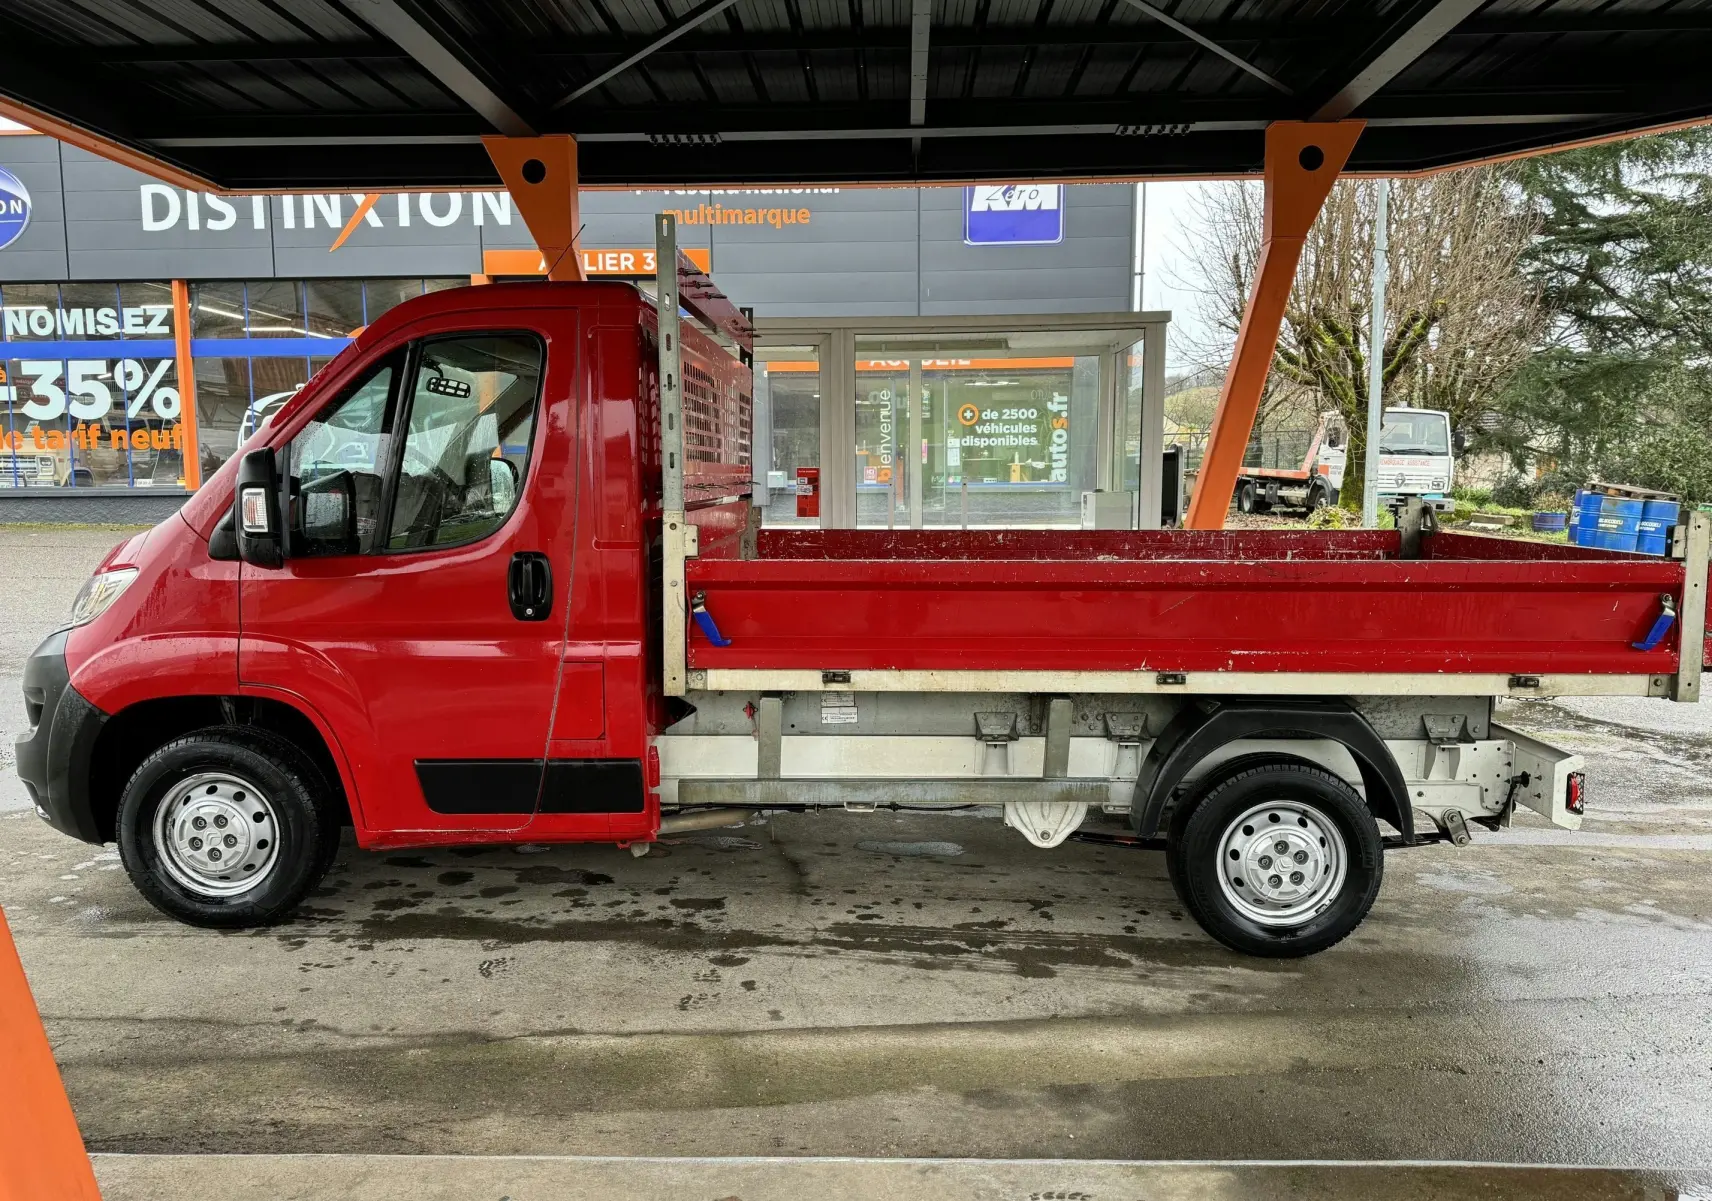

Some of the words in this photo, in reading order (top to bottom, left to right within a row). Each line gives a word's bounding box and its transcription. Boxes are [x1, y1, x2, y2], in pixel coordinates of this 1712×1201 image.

[140, 184, 512, 252] DISTINXION
[981, 408, 999, 420] de
[1001, 408, 1038, 420] 2500
[32, 423, 101, 450] tarif
[111, 423, 184, 450] neuf
[975, 422, 1038, 434] véhicules
[1047, 391, 1068, 482] autos.fr
[961, 435, 1038, 448] disponibles
